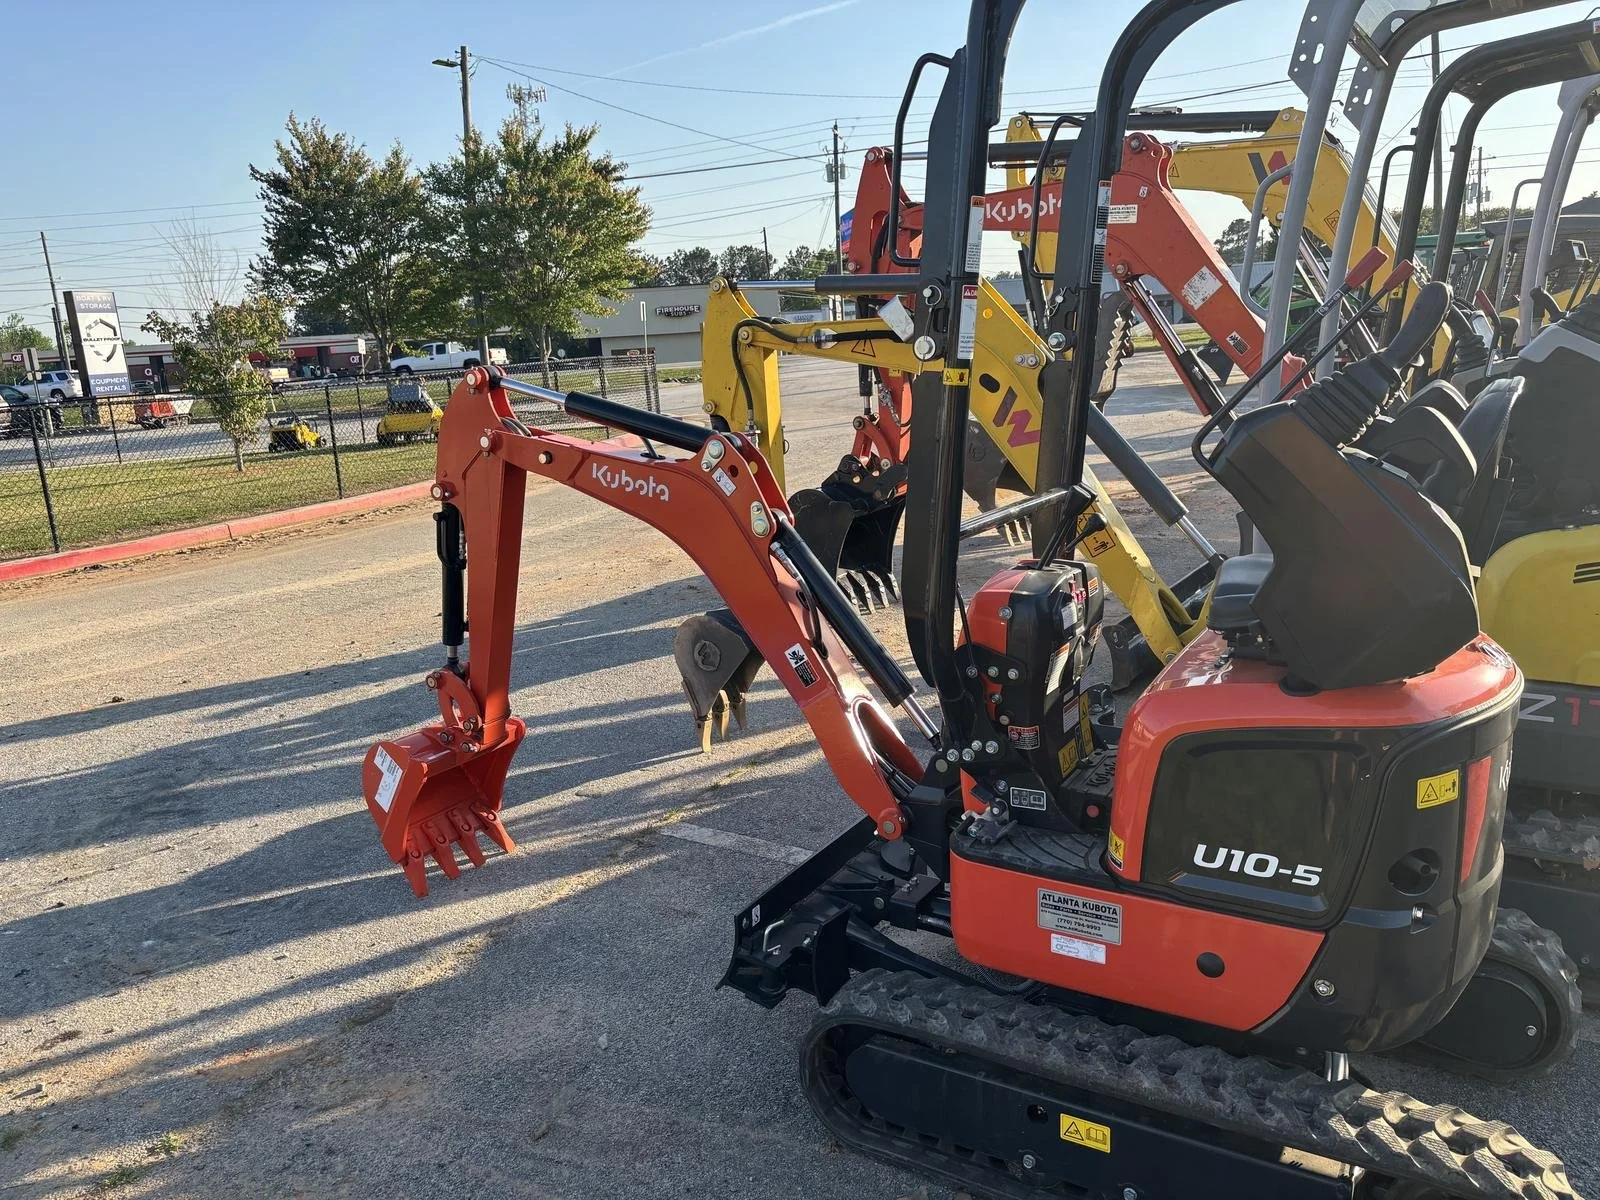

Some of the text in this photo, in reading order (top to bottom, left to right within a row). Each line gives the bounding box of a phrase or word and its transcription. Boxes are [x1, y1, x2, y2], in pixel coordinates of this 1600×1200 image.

[986, 192, 1062, 223] Kubot
[656, 305, 700, 316] FIREHOUSE
[90, 376, 129, 385] EQUIPMENT
[592, 462, 670, 502] Kubota
[1193, 843, 1323, 887] U10-5
[1041, 893, 1118, 916] ATLANTA KUBOTA
[1057, 917, 1073, 926] (770)
